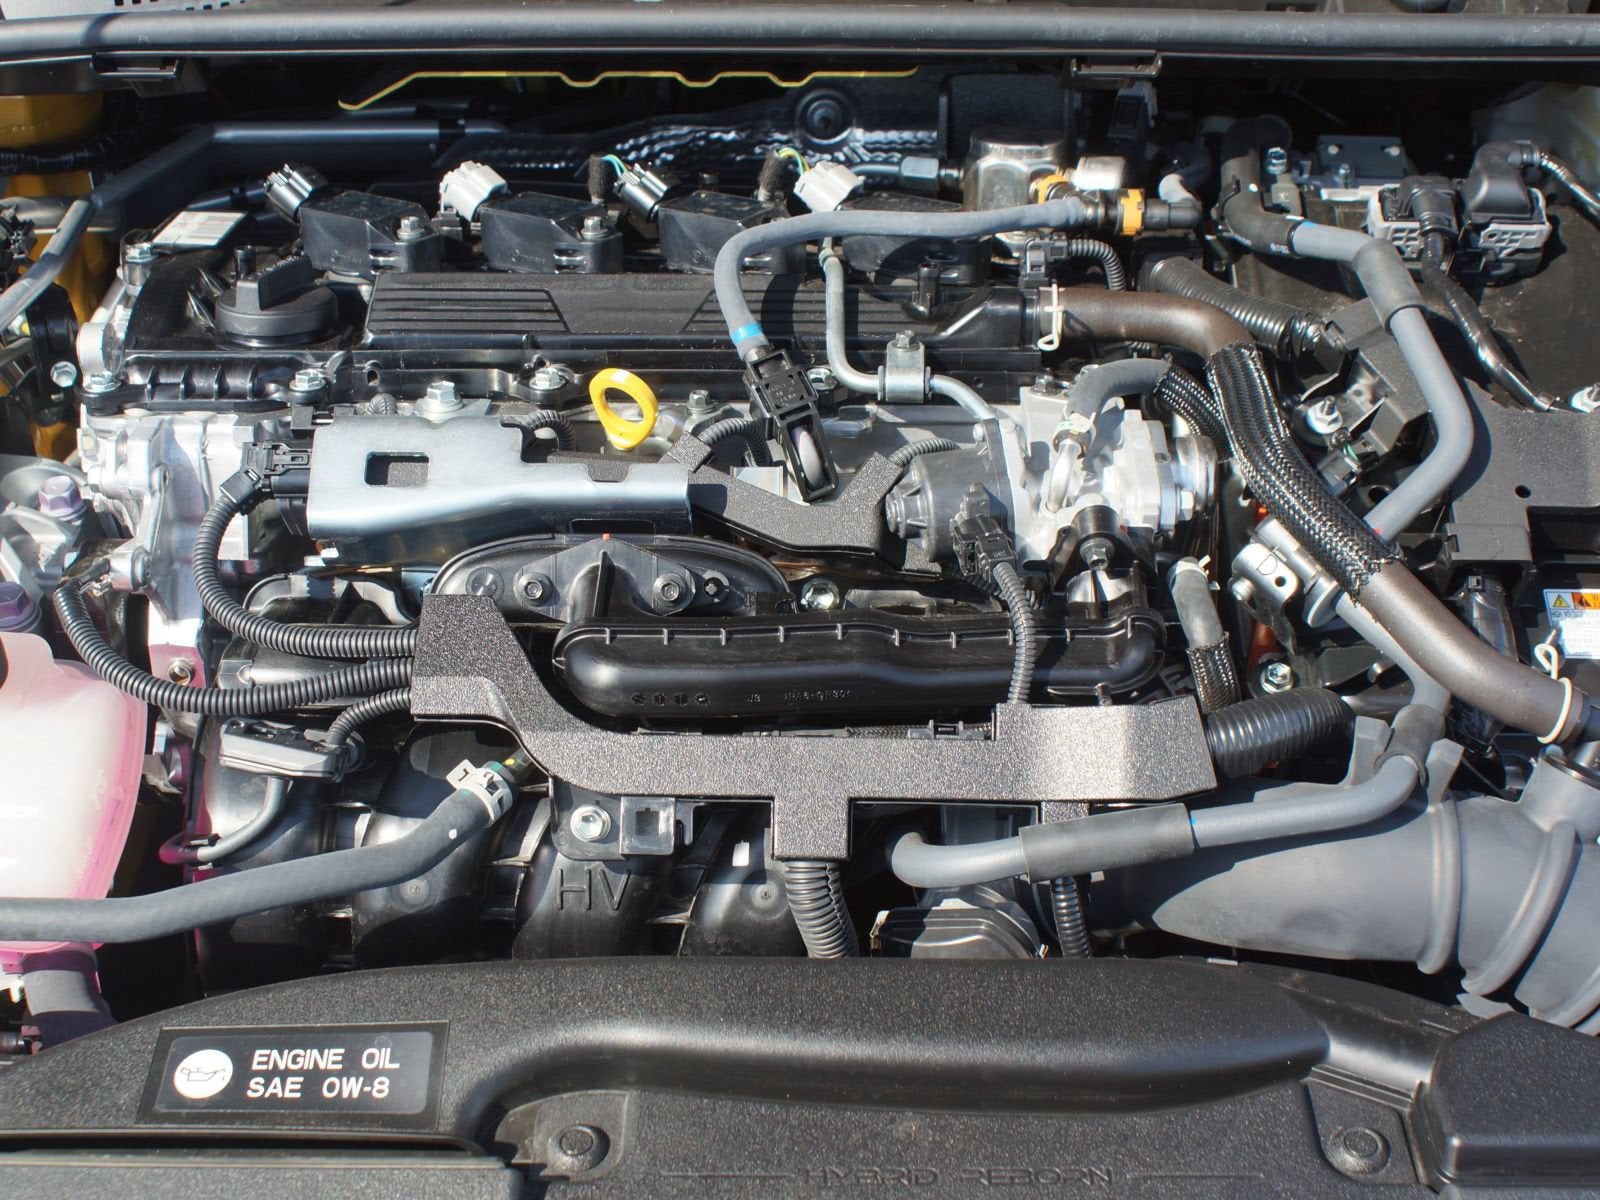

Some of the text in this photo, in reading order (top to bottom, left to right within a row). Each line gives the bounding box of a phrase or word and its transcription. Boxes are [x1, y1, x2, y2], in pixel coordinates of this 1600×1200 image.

[556, 867, 631, 911] HV
[251, 1047, 400, 1071] ENGINE OIL
[246, 1076, 390, 1098] SAE 0W-8
[803, 1166, 1113, 1187] HYBRID REBORN
